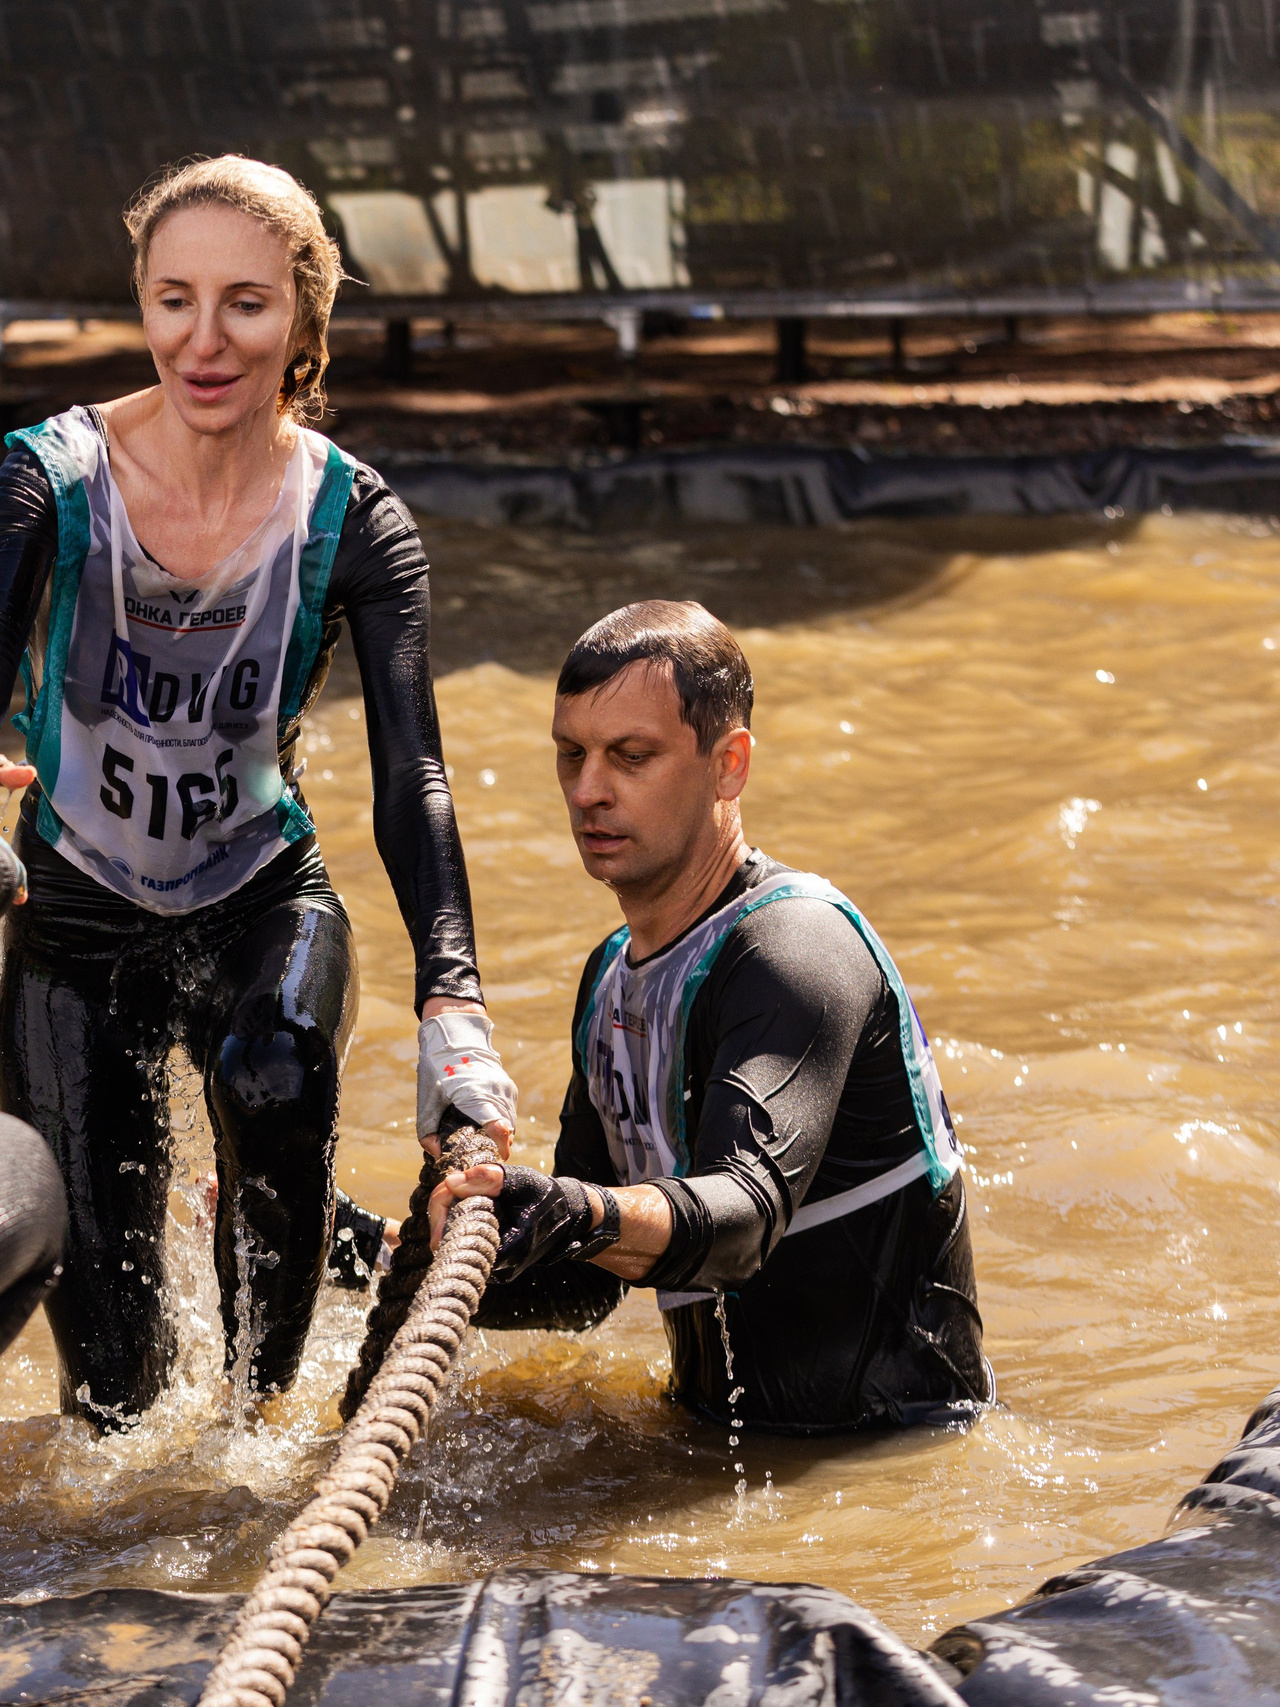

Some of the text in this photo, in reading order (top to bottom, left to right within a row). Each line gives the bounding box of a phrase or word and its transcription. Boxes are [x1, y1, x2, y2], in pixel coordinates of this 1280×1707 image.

[124, 597, 247, 627] ОНКА ГЕРОЕВ
[141, 845, 229, 892] ГАЗПРОМБАНК
